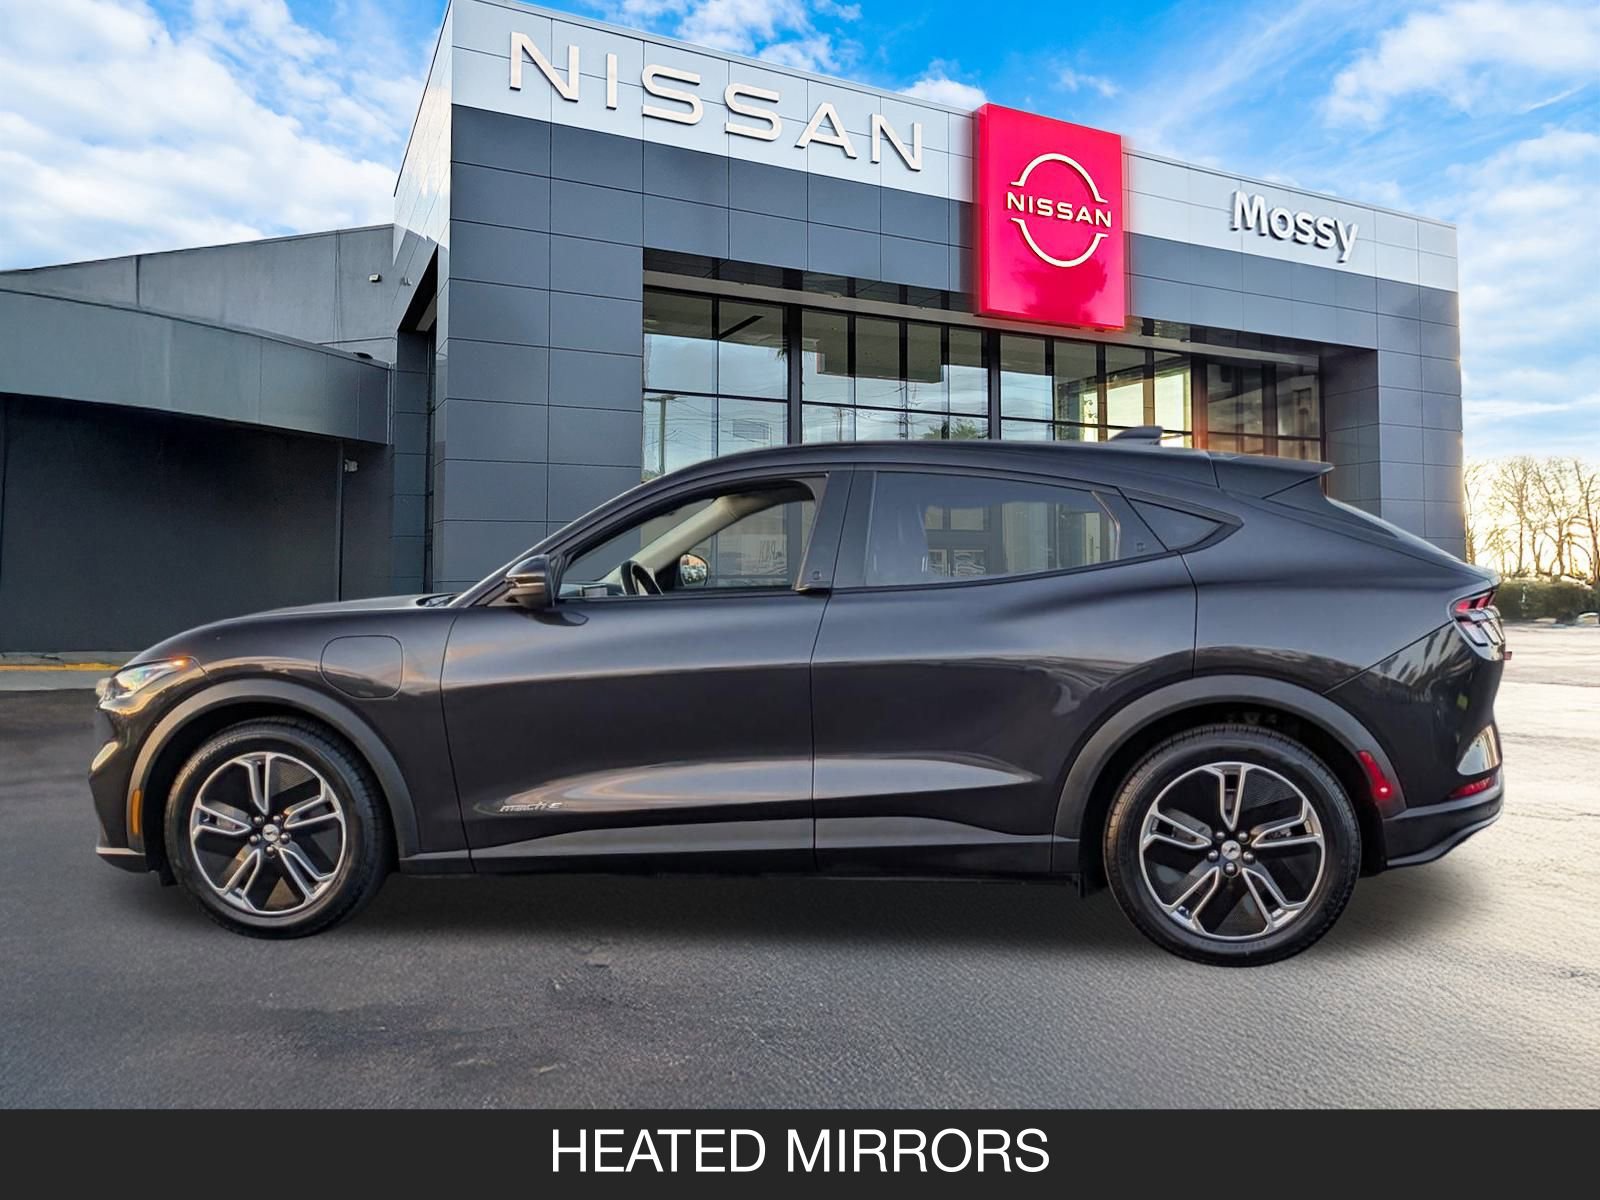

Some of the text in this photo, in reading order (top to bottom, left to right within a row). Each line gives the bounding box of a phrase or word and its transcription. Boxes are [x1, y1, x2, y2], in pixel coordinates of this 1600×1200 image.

[508, 31, 923, 172] NISSAN
[1006, 191, 1112, 228] NISSAN
[1231, 190, 1359, 263] Mossy
